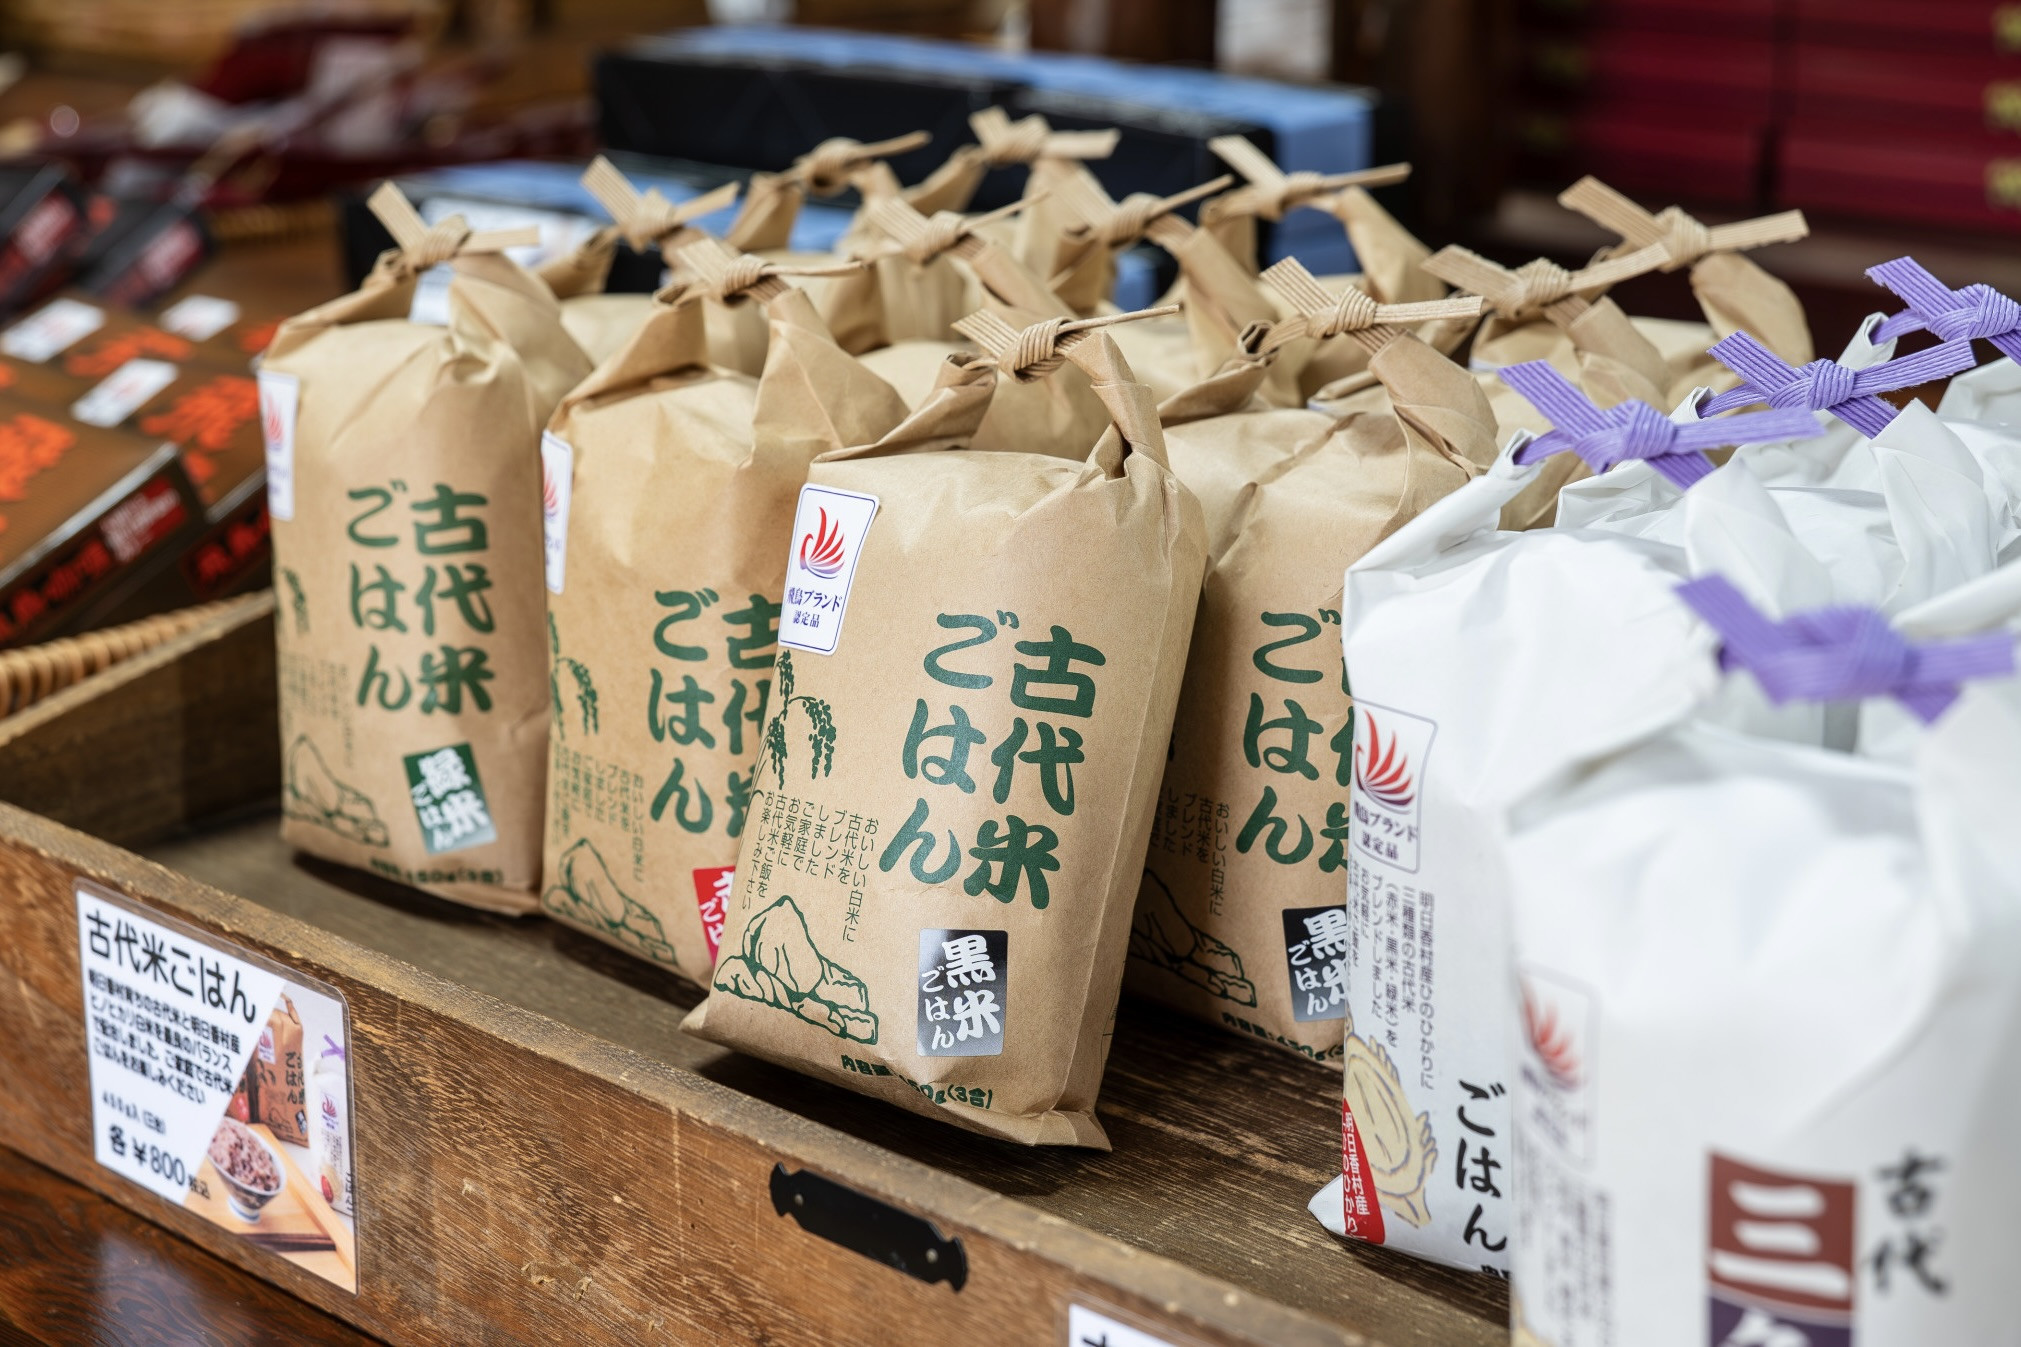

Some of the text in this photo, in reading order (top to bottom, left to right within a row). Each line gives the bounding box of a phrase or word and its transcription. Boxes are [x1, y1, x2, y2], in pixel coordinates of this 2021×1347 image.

[346, 479, 414, 711] ごはん
[410, 483, 496, 715] 古代米
[792, 610, 821, 628] 認定品
[647, 587, 719, 833] ごはん
[879, 610, 1019, 884] ごはん
[1236, 608, 1342, 865] ごはん
[963, 624, 1107, 911] 古代米
[742, 791, 774, 910] お楽しみ下さい
[757, 793, 788, 898] 古代米ご飯を
[777, 797, 801, 867] お気軽に
[792, 801, 815, 871] ご家庭で
[805, 805, 829, 876] しました
[823, 809, 848, 879] ブレンド
[837, 813, 863, 885] 古代米を
[842, 817, 878, 943] おいしい白米に
[1209, 803, 1230, 917] おいしい白米に
[87, 909, 256, 1024] 古代米ごはん
[921, 965, 956, 1050] ごはん
[941, 934, 1001, 1041] 黒米
[1288, 939, 1329, 1016] ごはん
[1455, 1079, 1507, 1252] ごはん
[1870, 1147, 1951, 1302] 古代
